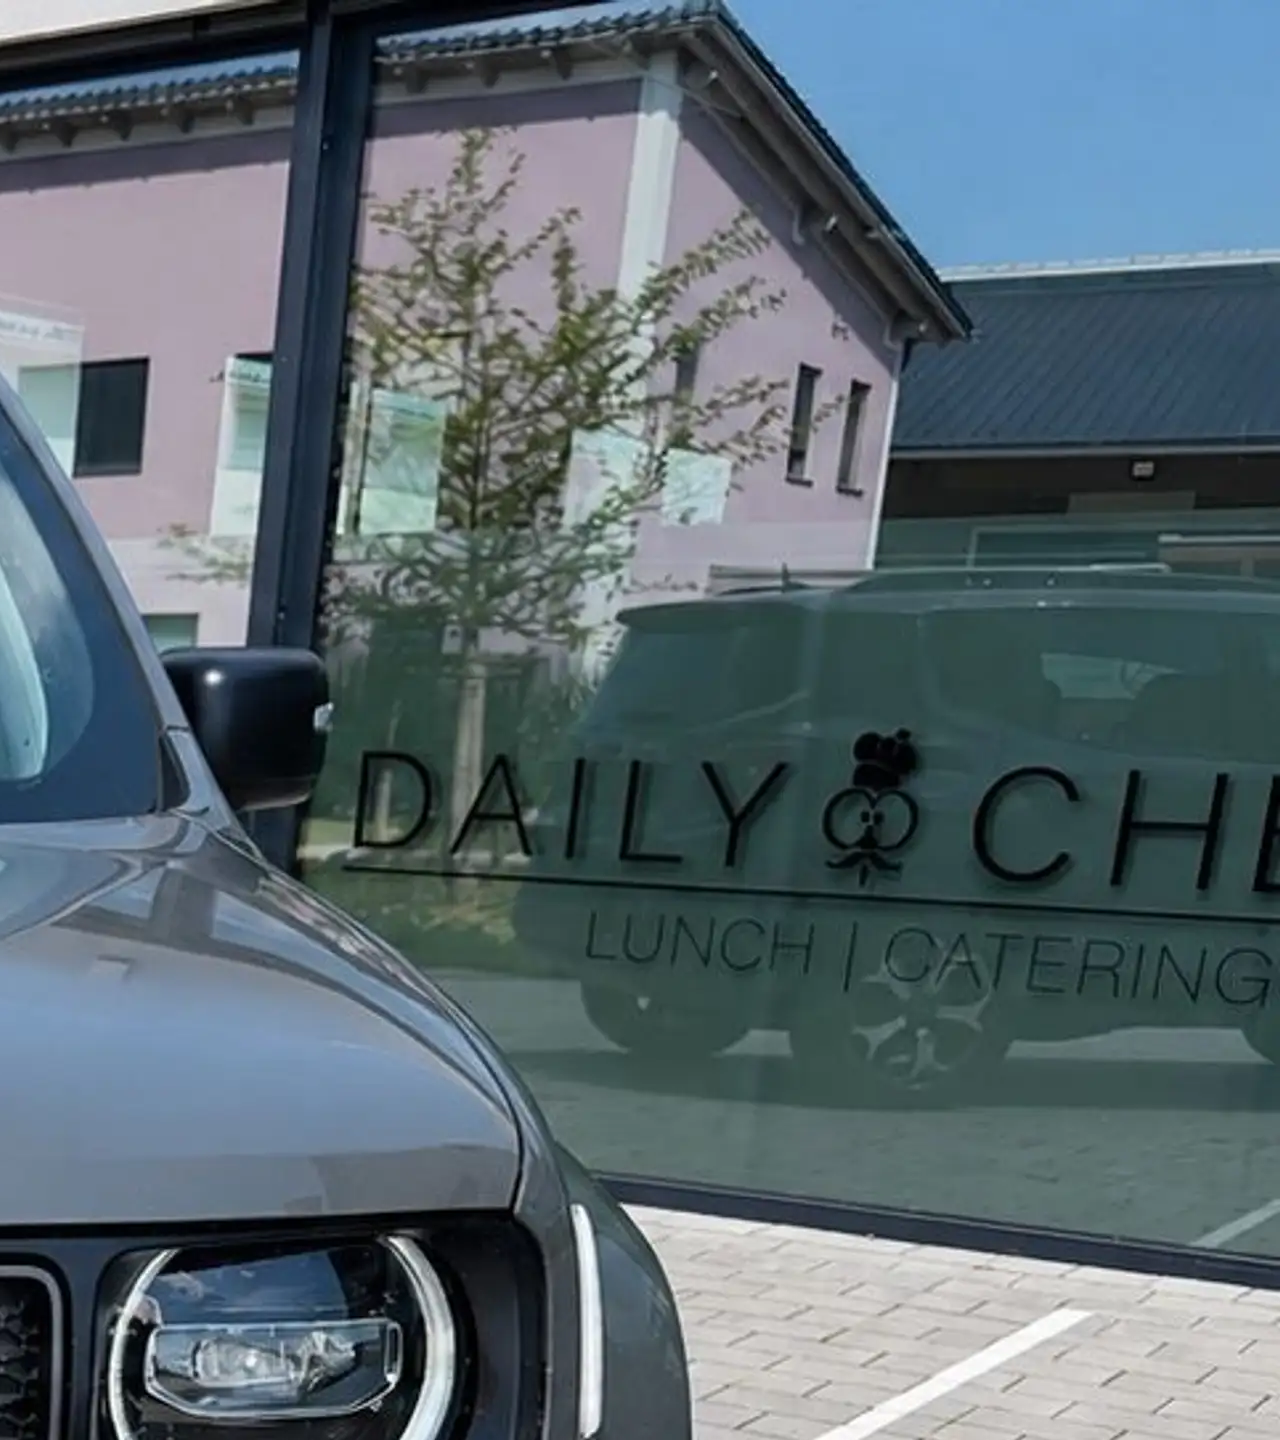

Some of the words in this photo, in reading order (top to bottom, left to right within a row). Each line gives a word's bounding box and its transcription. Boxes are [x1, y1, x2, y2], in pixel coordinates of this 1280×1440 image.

[353, 751, 791, 869] DAILY
[586, 911, 815, 975] LUNCH
[886, 928, 1274, 1008] CATERING
